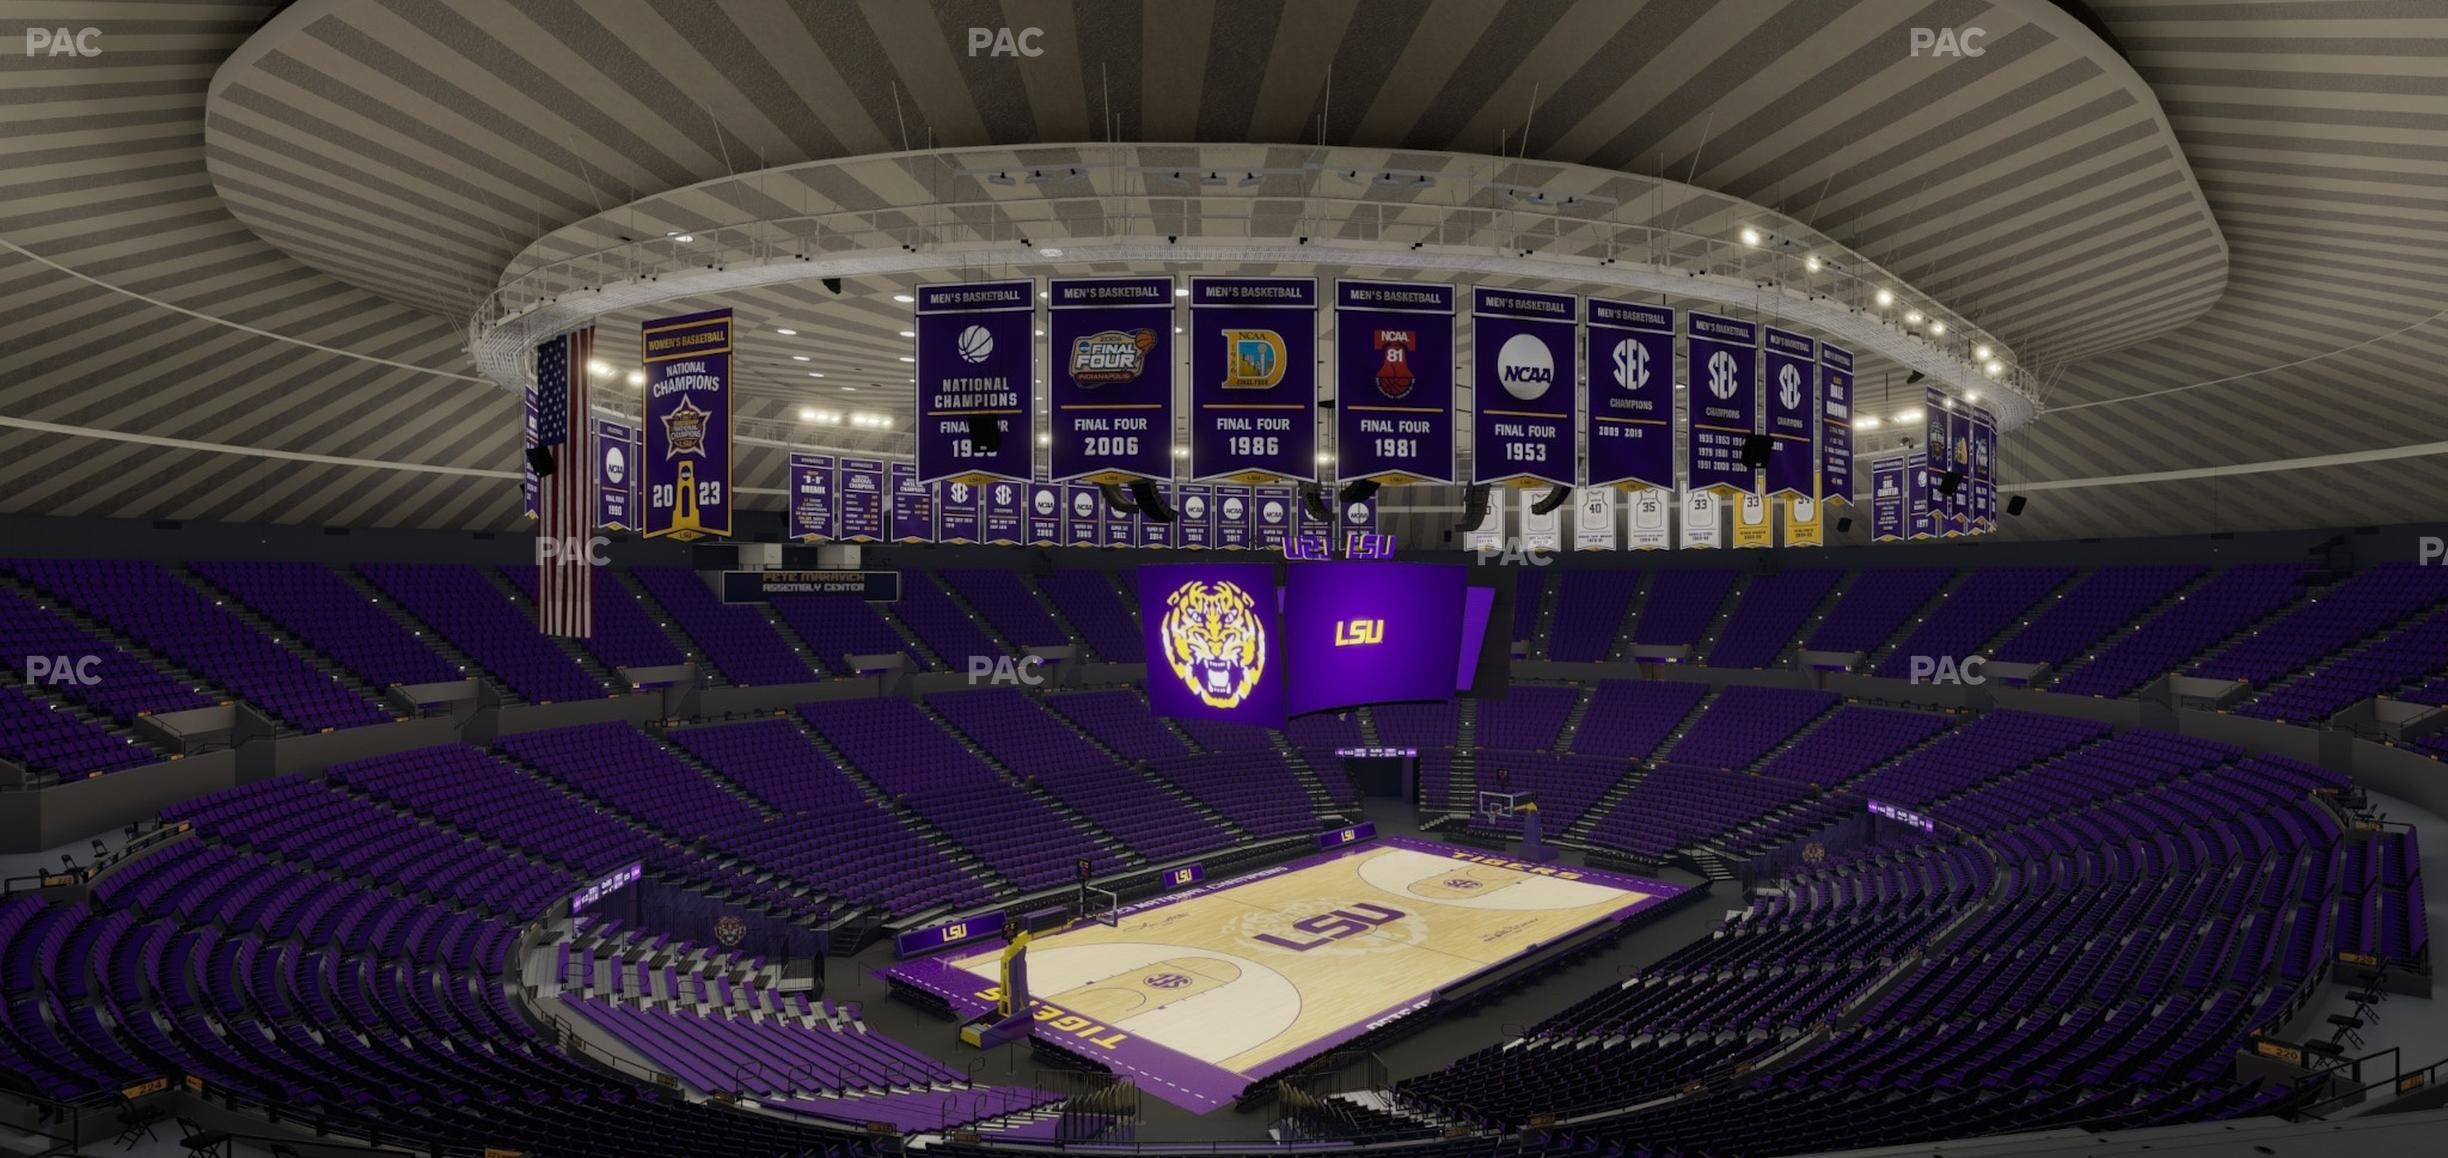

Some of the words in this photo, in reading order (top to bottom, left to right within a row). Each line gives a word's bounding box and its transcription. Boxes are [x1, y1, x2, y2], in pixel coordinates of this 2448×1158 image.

[931, 293, 961, 304] MEN'S
[963, 290, 1020, 303] BASKETBALL
[1065, 287, 1097, 299] MEN'S
[1099, 285, 1160, 299] BASKETBALL
[1206, 286, 1239, 298] MEN'S
[1240, 286, 1302, 299] BASKETBALL
[1350, 289, 1382, 301] MEN'S
[1384, 290, 1441, 304] BASKETBALL
[1485, 296, 1514, 309] MEN'S
[1516, 299, 1565, 313] BASKETBALL
[1597, 307, 1622, 320] MEN'S
[1623, 310, 1665, 325] BASKETBALL
[649, 337, 681, 351] WOMEN'S
[682, 330, 725, 346] BASKETBALL
[1239, 332, 1266, 340] NCAA
[1381, 331, 1408, 342] NCAA
[1092, 343, 1135, 354] FINAL
[1387, 349, 1404, 362] 81
[1076, 353, 1135, 369] FOUR
[1612, 338, 1651, 390] SEC
[666, 361, 706, 377] NATIONAL
[1504, 366, 1552, 384] NCAA
[1708, 351, 1739, 400] SEC
[653, 376, 720, 398] CHAMPIONS
[942, 378, 1009, 392] NATIONAL
[1779, 364, 1801, 410] SEC
[934, 393, 1018, 408] CHAMPIONS
[1610, 398, 1652, 411] CHAMPIONS
[1705, 407, 1740, 419] CHAMPIONS
[940, 421, 970, 434] FINA
[1074, 418, 1110, 431] FINAL
[1114, 417, 1148, 431] FOUR
[1216, 418, 1252, 431] FINAL
[1257, 418, 1290, 431] FOUR
[1360, 420, 1394, 433] FINAL
[1398, 420, 1430, 434] FOUR
[1495, 424, 1524, 437] FINAL
[1528, 425, 1556, 438] FOUR
[1599, 426, 1619, 437] 2009
[1084, 437, 1139, 456] 2006
[1229, 437, 1279, 456] 1986
[1375, 439, 1417, 458] 1981
[1506, 443, 1546, 462] 1953
[653, 484, 673, 508] 20
[699, 481, 721, 505] 23
[995, 485, 1012, 505] SEC
[1589, 503, 1602, 514] 40
[1642, 502, 1656, 513] 35
[1694, 499, 1708, 510] 33
[1746, 496, 1759, 508] 33
[1345, 534, 1397, 560] LSU
[762, 573, 799, 582] PETE
[801, 573, 865, 583] MARAVICH
[762, 583, 822, 592] ASSEMBLY
[824, 583, 865, 592] CENTER
[1335, 620, 1385, 647] LSU
[1340, 830, 1355, 843] LSU
[1452, 850, 1584, 881] TIGERS
[1175, 867, 1192, 885] LSU
[942, 923, 968, 943] LSU
[1253, 903, 1407, 952] LSU
[975, 987, 1128, 1051] TIGES
[2276, 1049, 2298, 1060] 220
